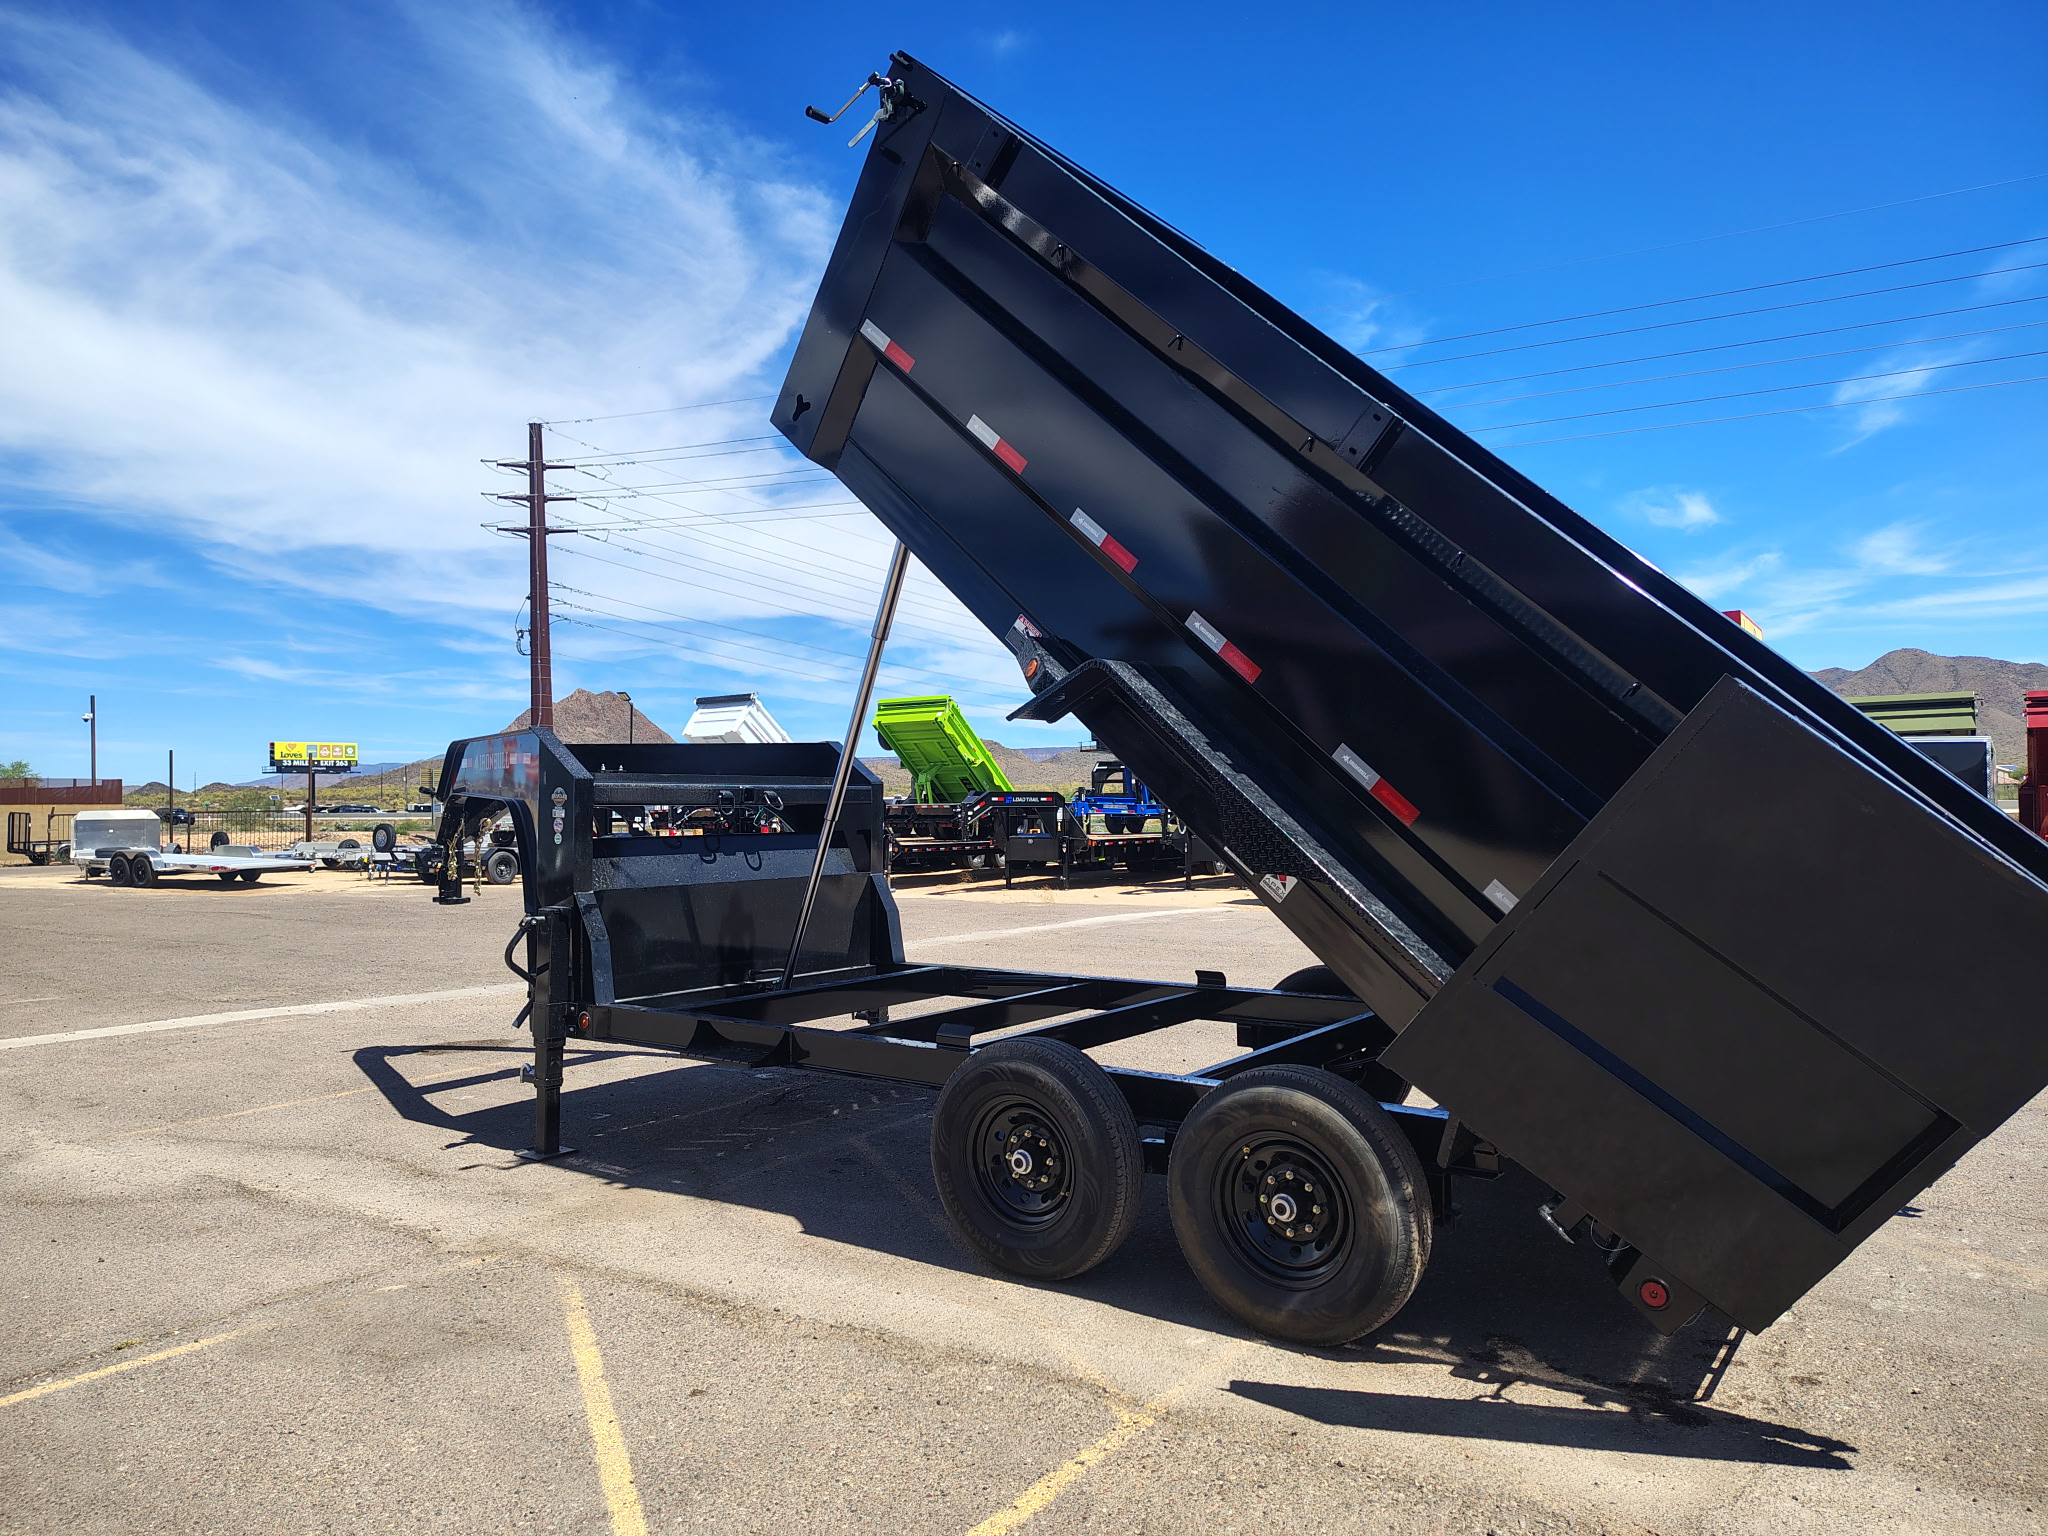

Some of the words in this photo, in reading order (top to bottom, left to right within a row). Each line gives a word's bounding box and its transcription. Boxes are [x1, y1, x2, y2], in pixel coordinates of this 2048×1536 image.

[480, 752, 510, 770] IRONBULL
[1264, 877, 1286, 897] APEX
[1034, 1075, 1089, 1142] RAMBLER
[940, 1170, 1005, 1258] TASKMASTER
